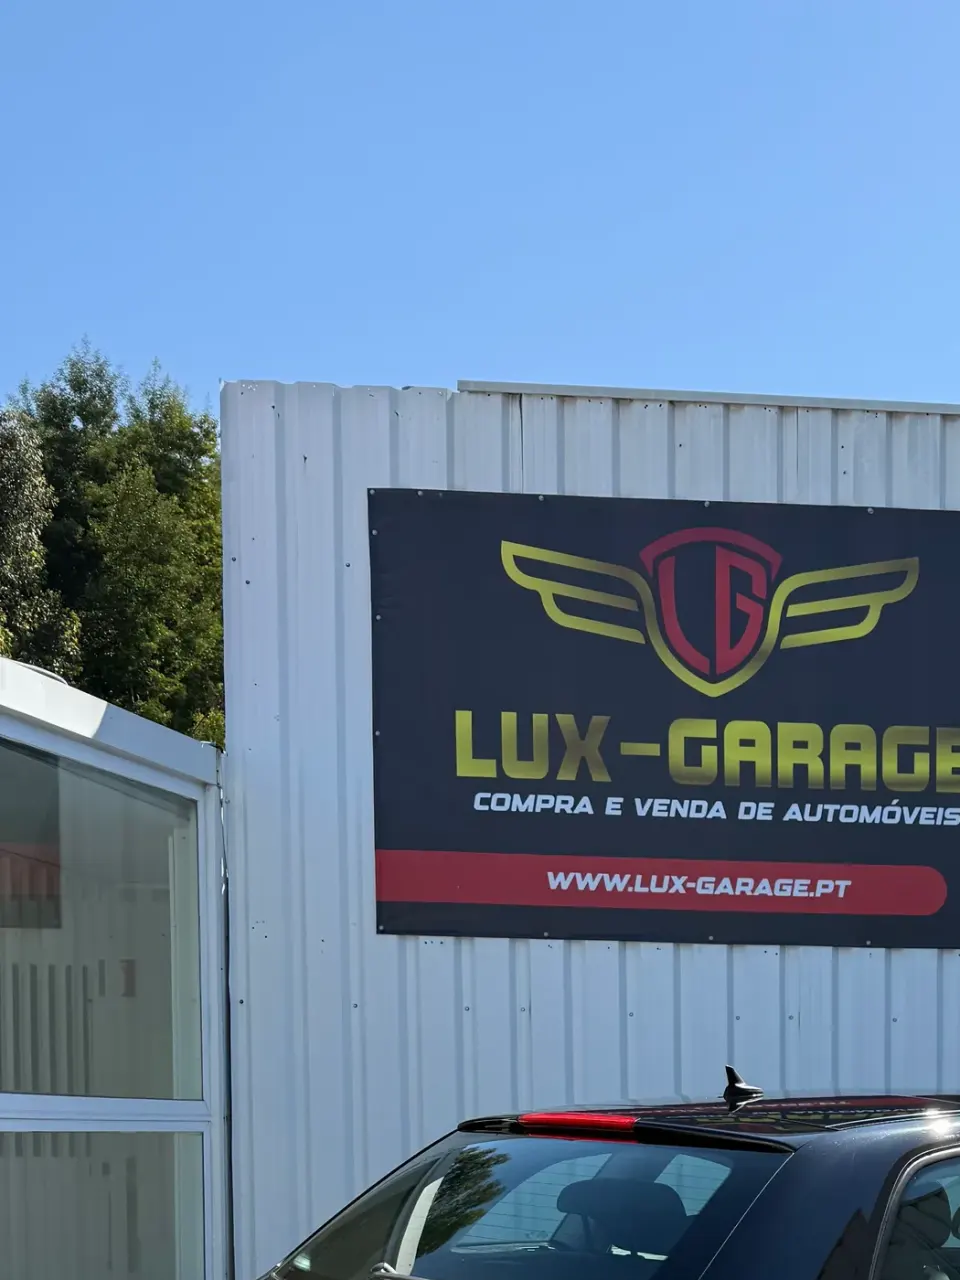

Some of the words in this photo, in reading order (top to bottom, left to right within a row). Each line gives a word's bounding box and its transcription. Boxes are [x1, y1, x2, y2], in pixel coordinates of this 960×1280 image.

[473, 793, 594, 816] COMPRA
[605, 797, 623, 816] E
[635, 798, 727, 821] VENDA
[738, 802, 775, 822] DE
[547, 871, 852, 899] WWW.LUX-GARAGE.PT
